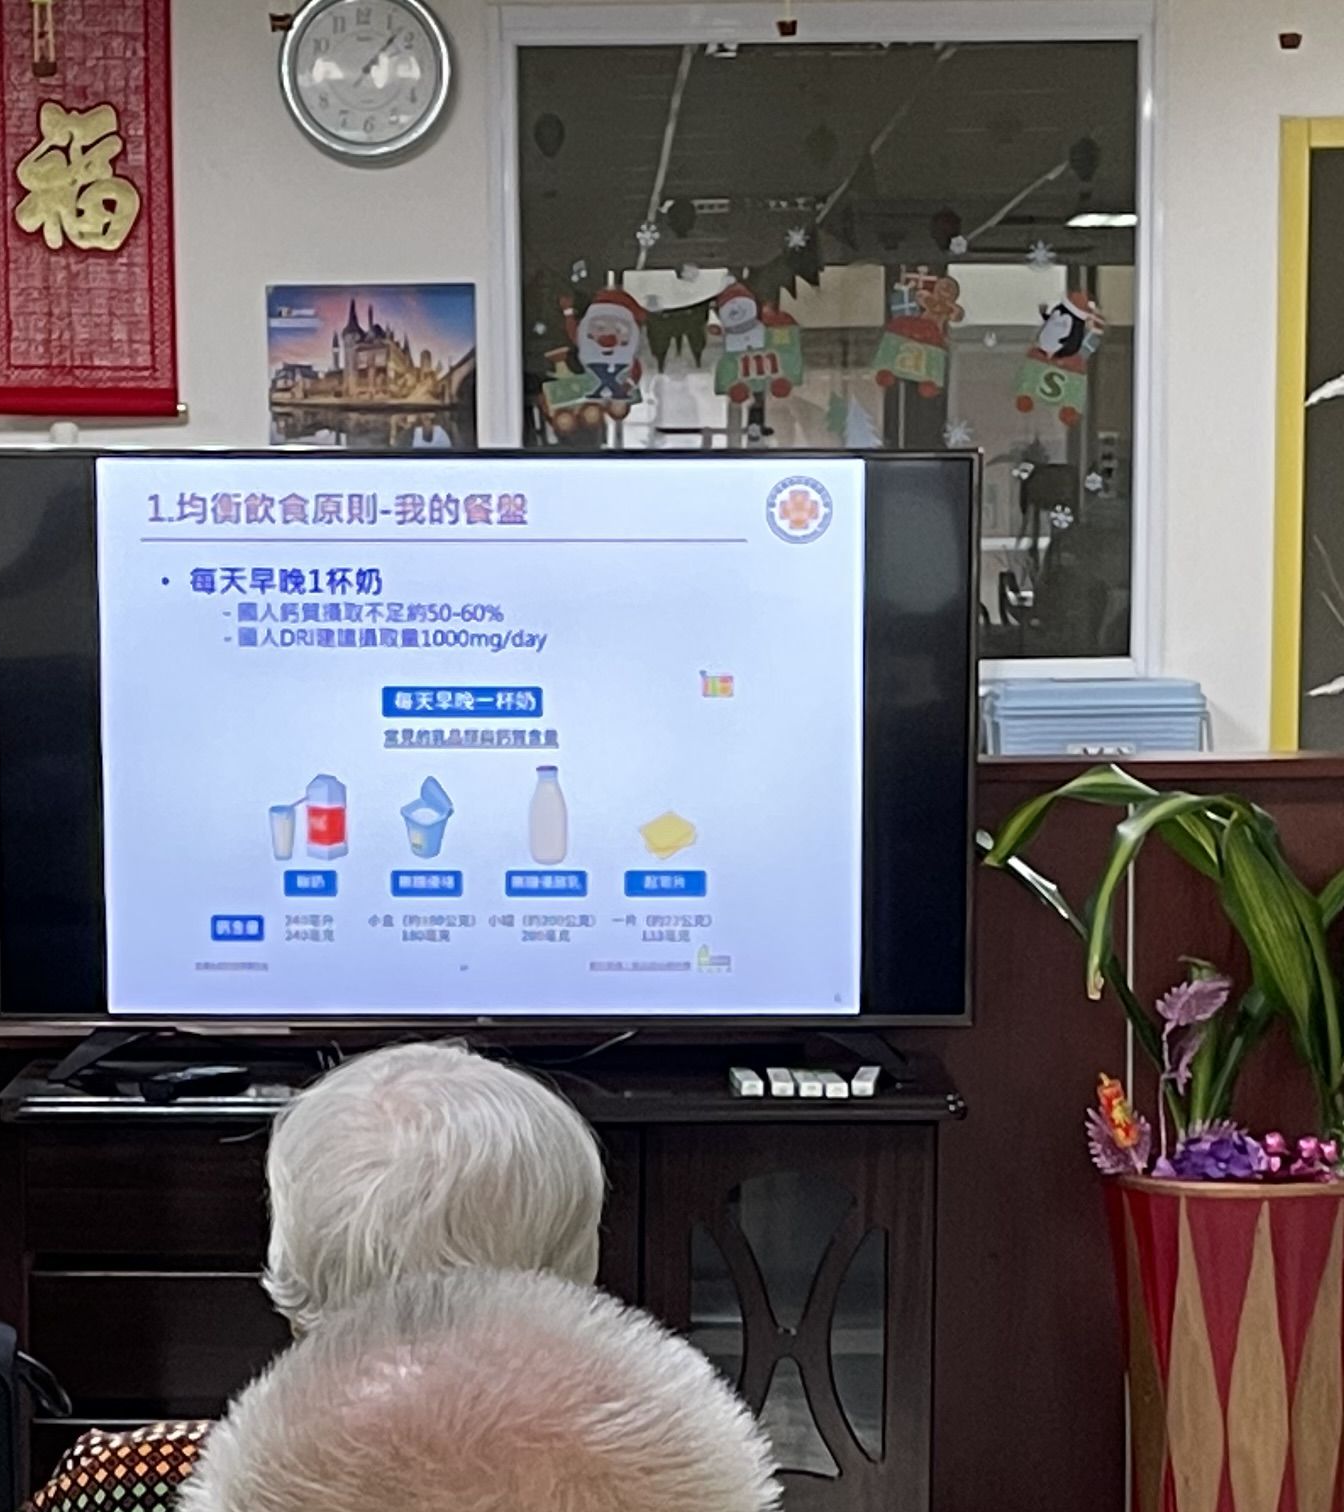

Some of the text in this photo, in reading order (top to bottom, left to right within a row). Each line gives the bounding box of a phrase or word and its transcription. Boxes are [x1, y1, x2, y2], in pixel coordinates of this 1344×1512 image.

[332, 16, 346, 33] 11
[15, 100, 141, 251] 福
[147, 492, 529, 526] 1.均衡飲食原則-我的餐盤
[190, 567, 382, 596] 每天早晚1杯奶
[394, 690, 537, 712] 每天早晚一杯奶
